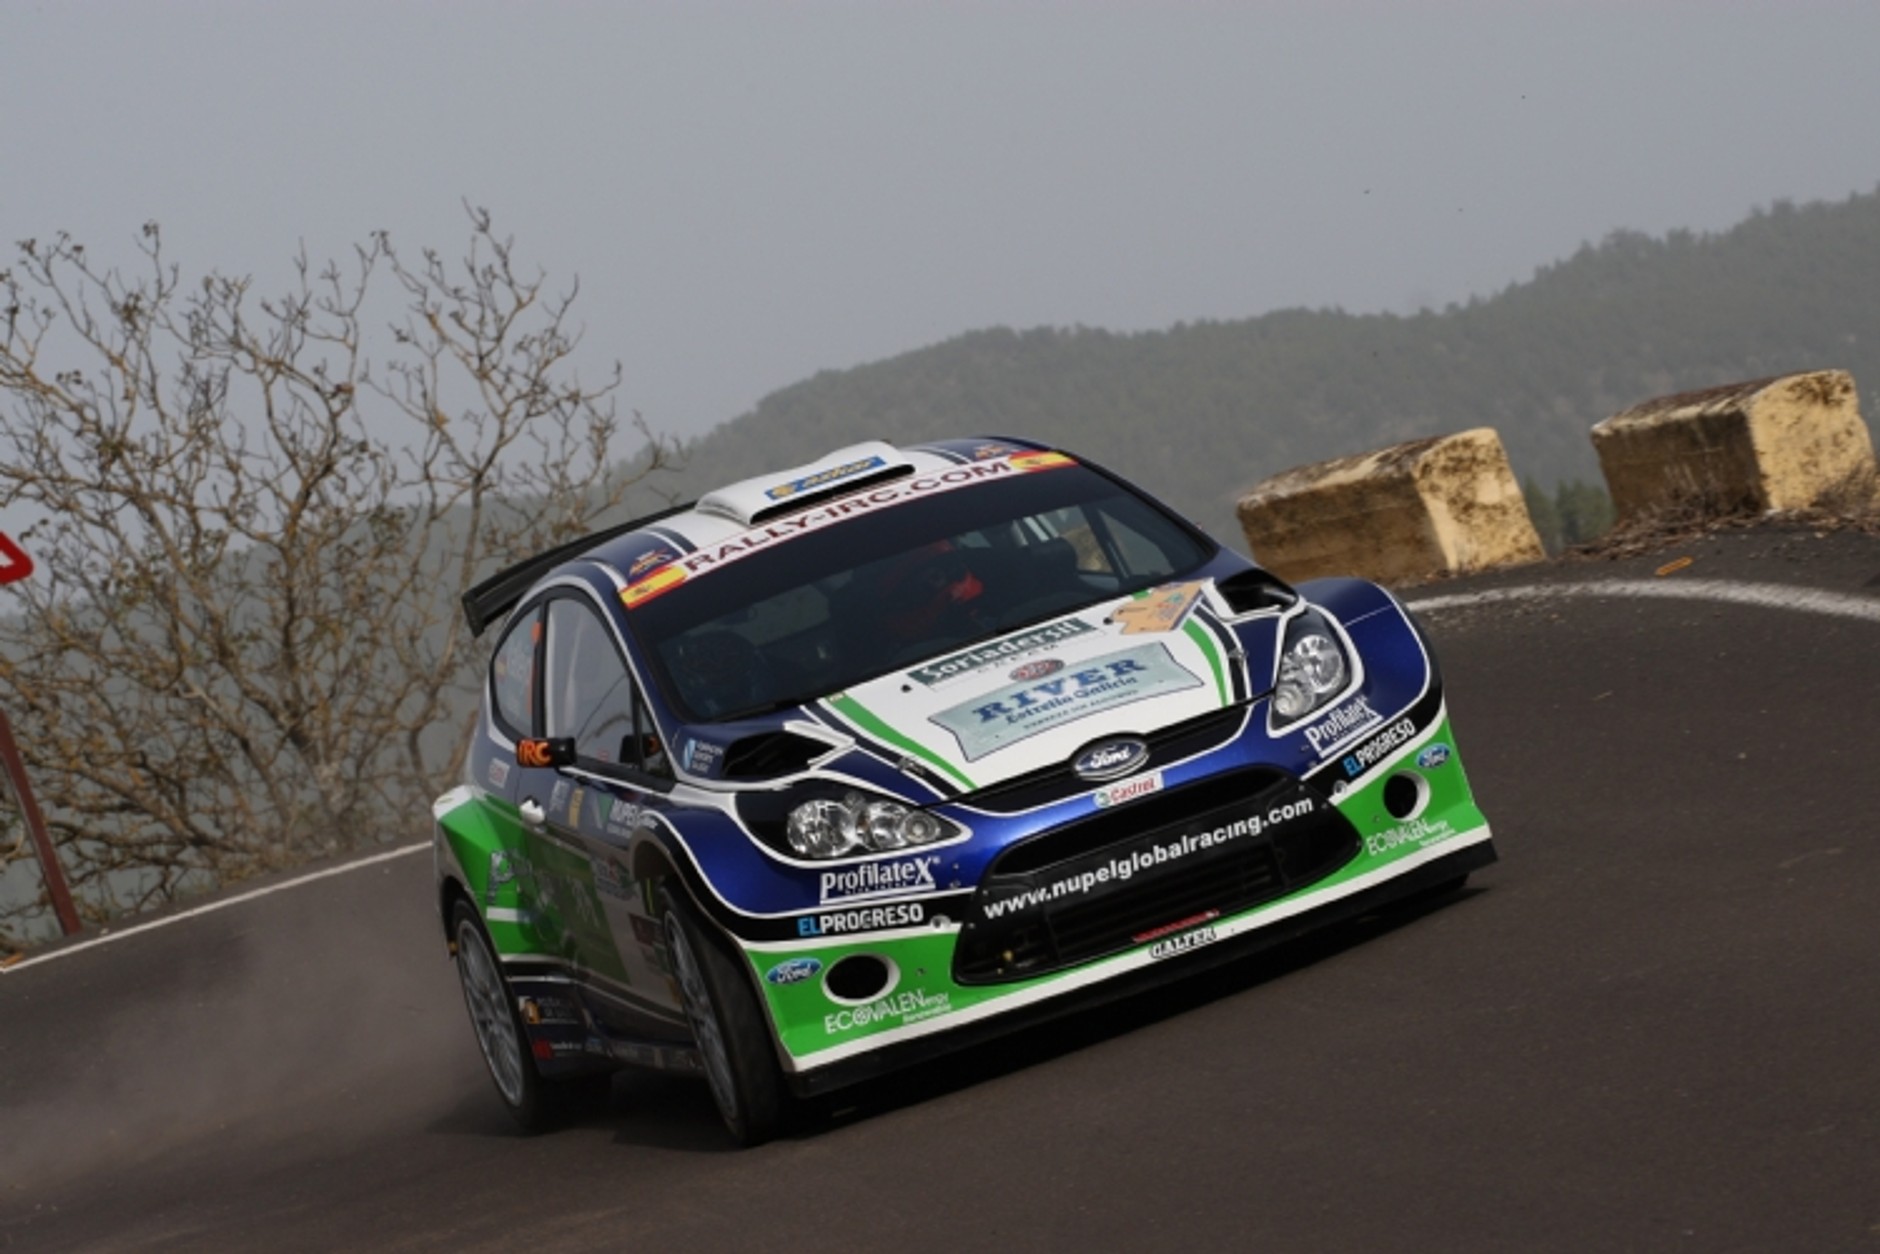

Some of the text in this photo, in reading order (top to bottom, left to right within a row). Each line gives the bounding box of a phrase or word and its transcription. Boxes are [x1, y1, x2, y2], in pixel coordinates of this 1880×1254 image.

[685, 462, 1012, 573] RALLY-IRC.COM
[972, 658, 1147, 723] RIVER
[1005, 693, 1073, 726] Estrella
[1074, 676, 1138, 700] Galicia
[518, 739, 551, 766] IRC
[1090, 743, 1130, 769] Ford
[1110, 778, 1156, 803] Castrol
[983, 798, 1314, 919] www.nupelglobalracing.com
[1149, 926, 1217, 959] GALFER
